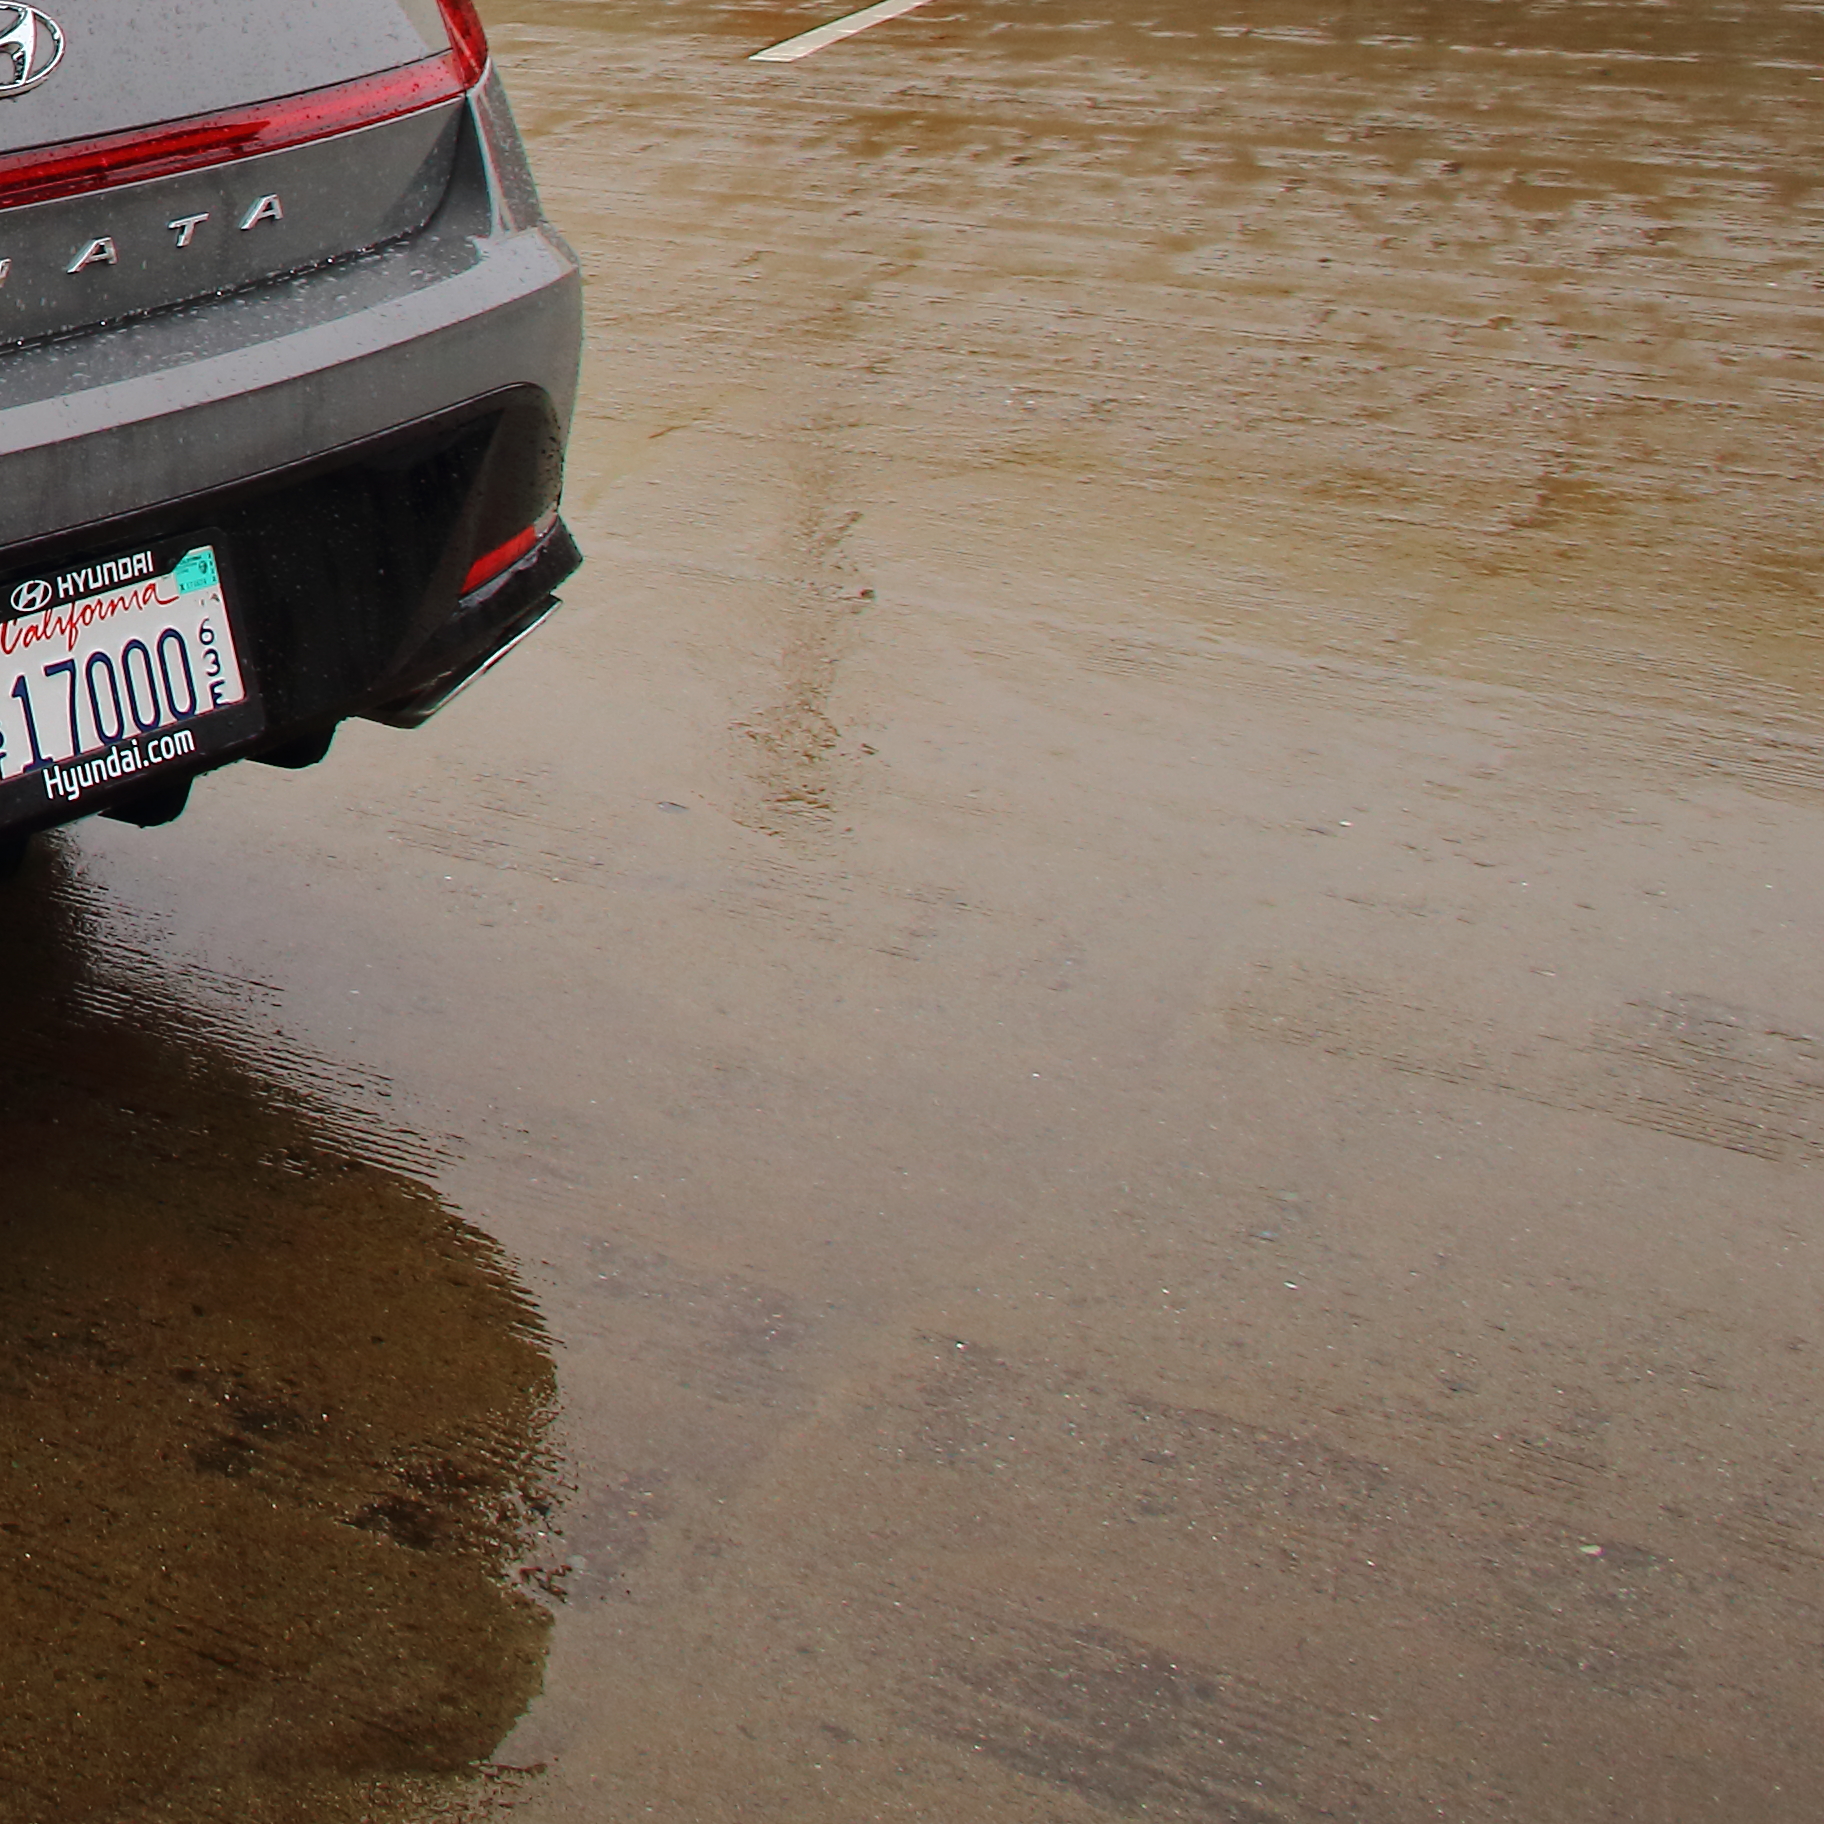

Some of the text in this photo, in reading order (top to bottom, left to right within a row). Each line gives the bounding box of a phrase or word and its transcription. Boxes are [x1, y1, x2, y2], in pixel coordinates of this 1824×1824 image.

[57, 551, 153, 598] HYUNDAI
[0, 582, 180, 654] California
[12, 628, 196, 773] 17000
[43, 729, 195, 801] Hyundai.com
